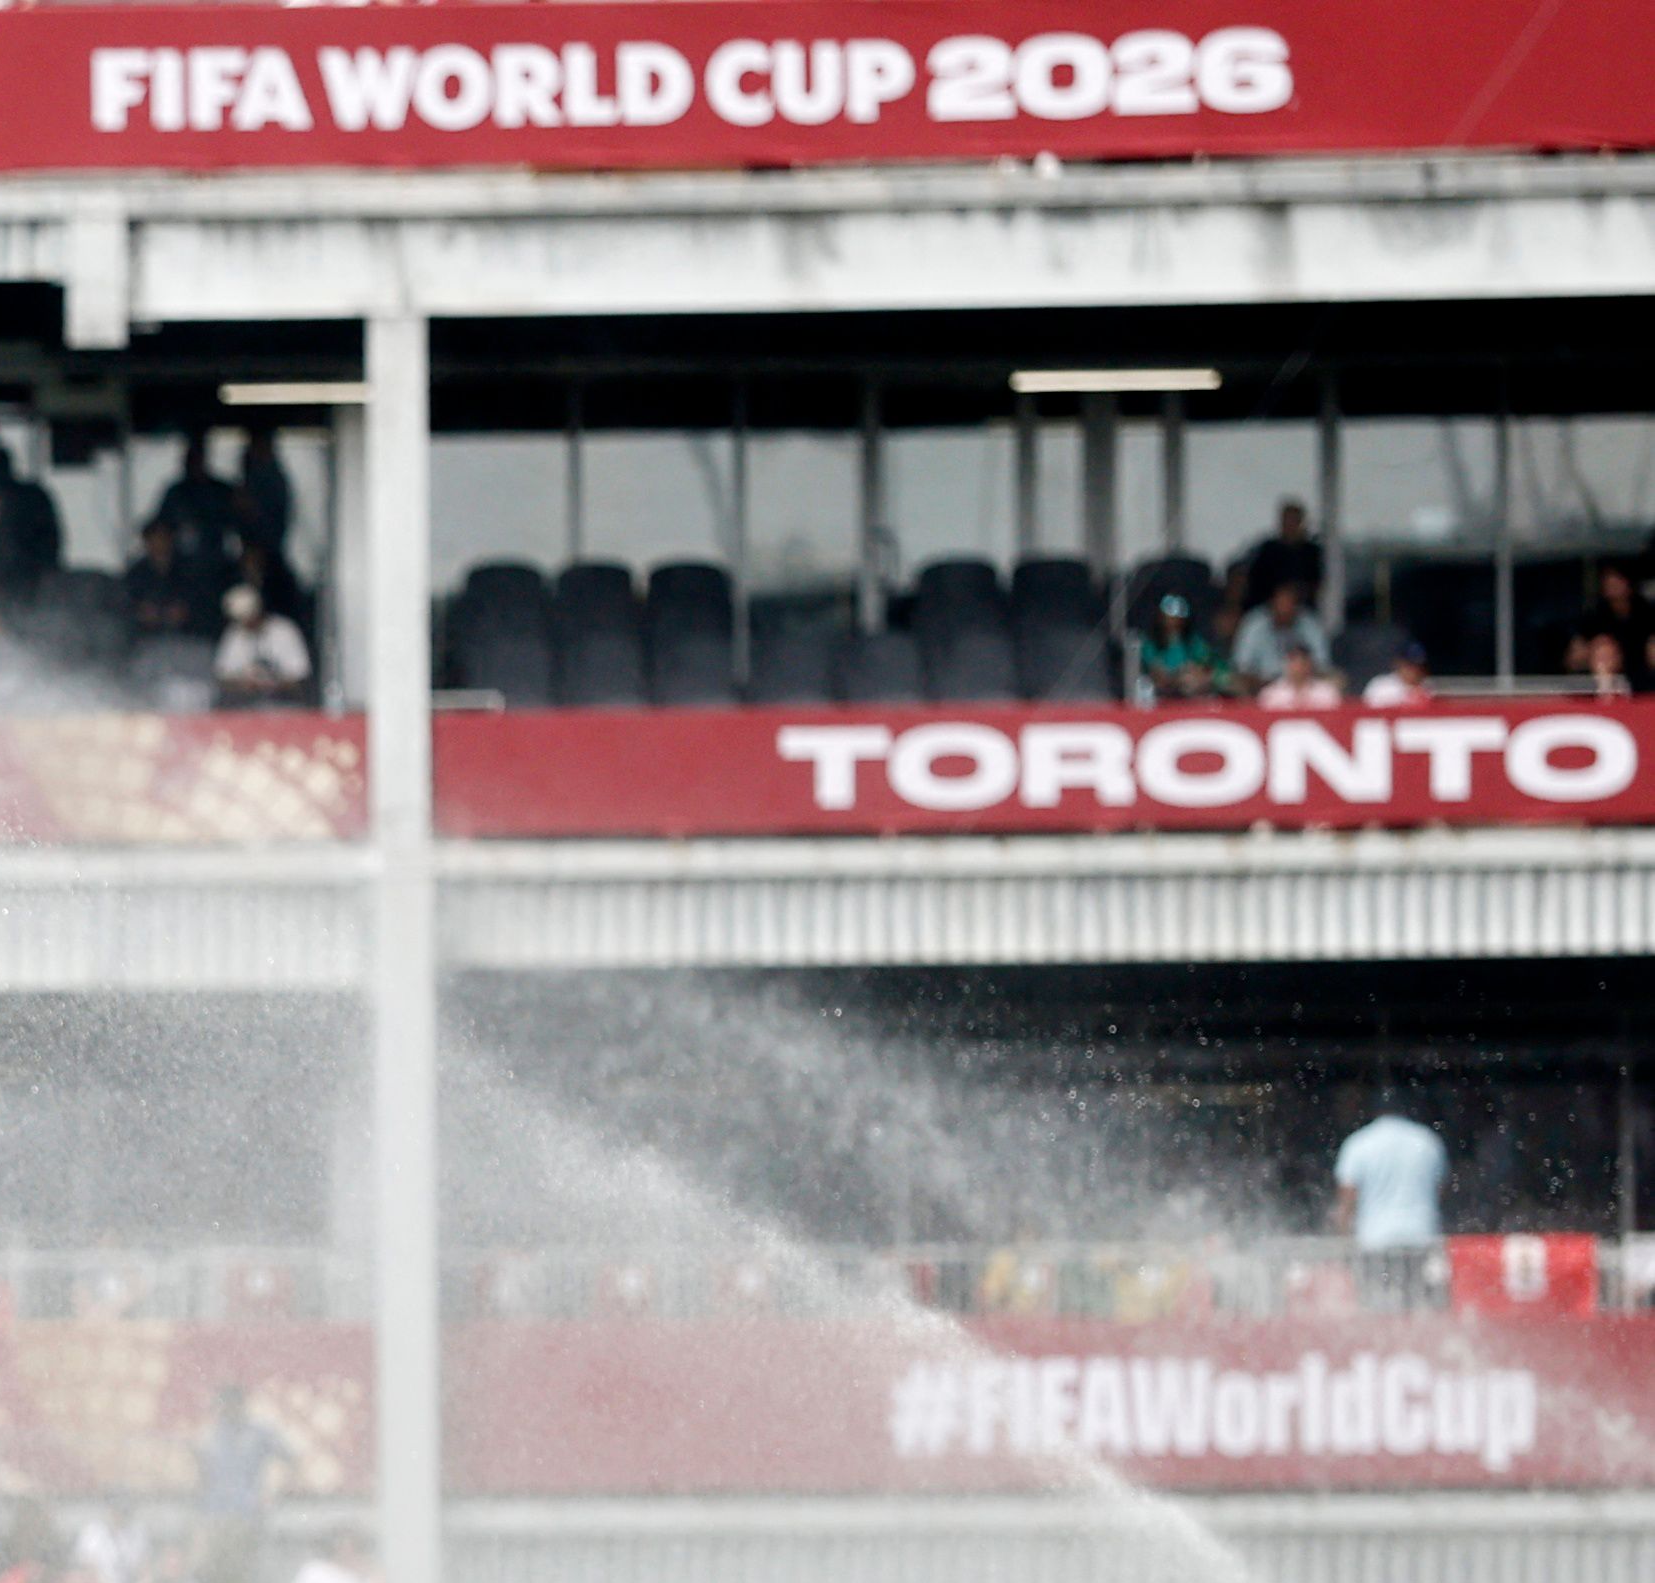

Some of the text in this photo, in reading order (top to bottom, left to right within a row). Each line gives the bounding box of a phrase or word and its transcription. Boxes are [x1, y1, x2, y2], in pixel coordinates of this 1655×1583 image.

[90, 25, 1294, 132] FIFA WORLD CUP 2026
[776, 714, 1638, 811] TORONTO
[890, 1350, 1538, 1473] #FIFAWorldCup
